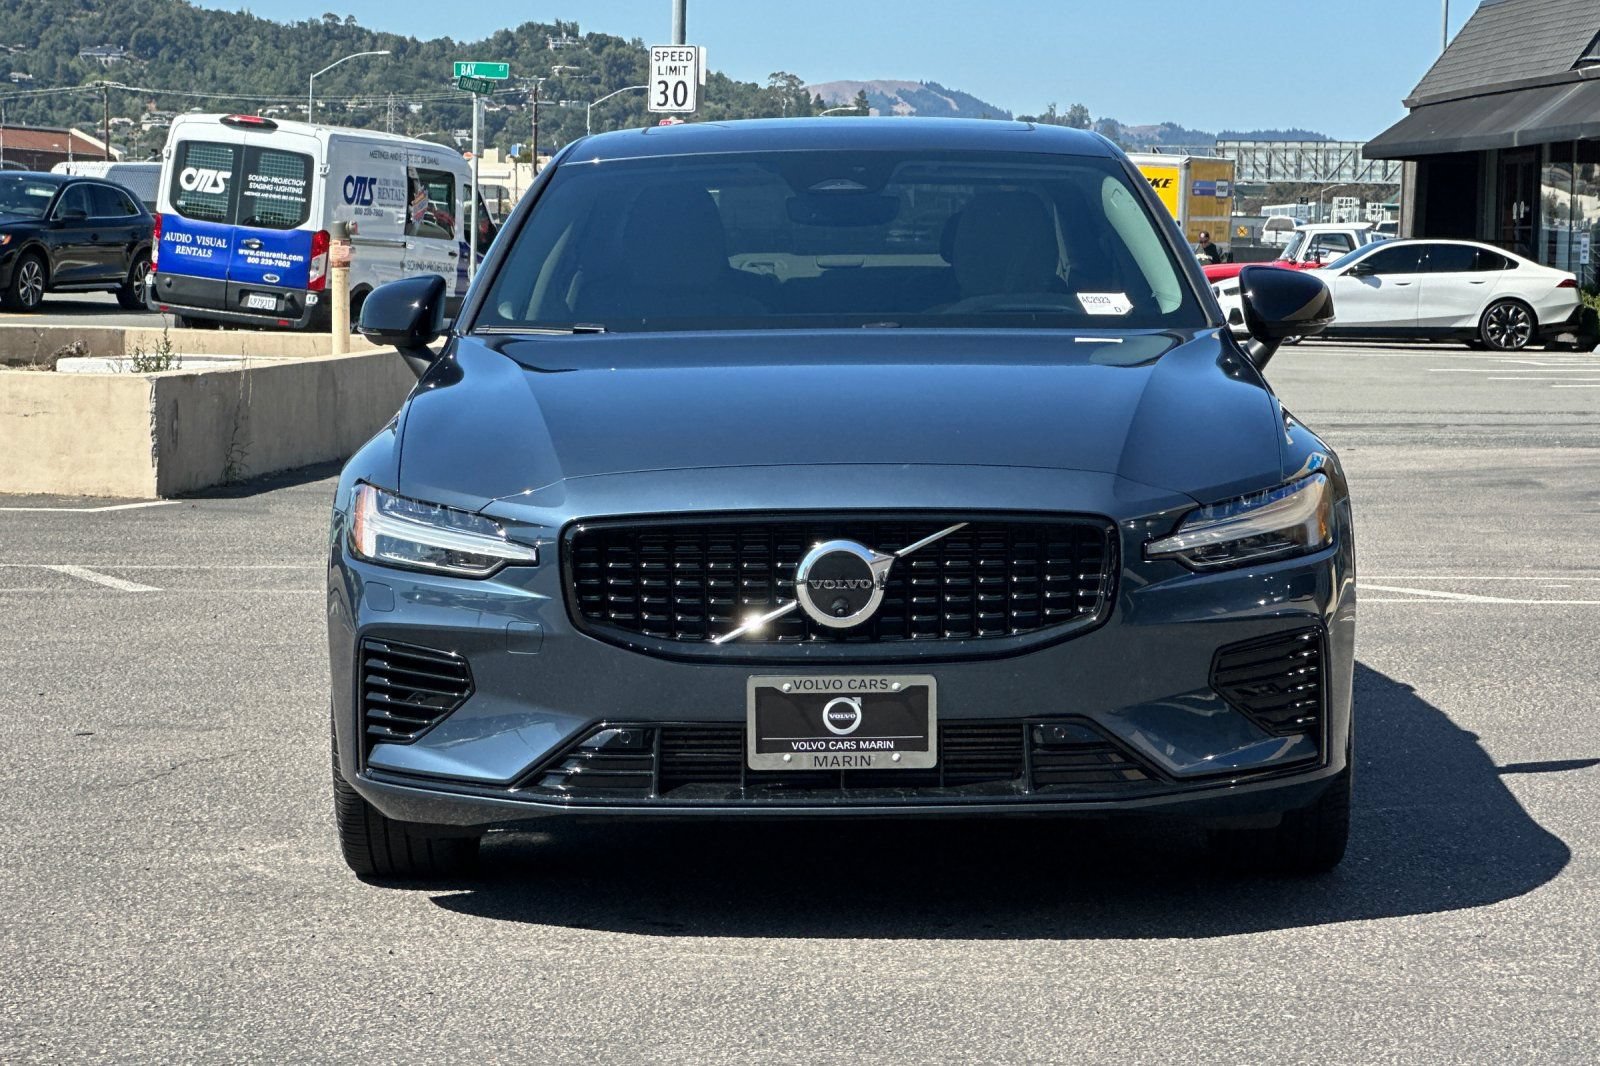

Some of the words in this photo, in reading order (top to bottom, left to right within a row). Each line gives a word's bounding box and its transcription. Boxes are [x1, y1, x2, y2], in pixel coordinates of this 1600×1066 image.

[654, 51, 693, 62] SPEED
[461, 64, 476, 76] BAY
[657, 65, 688, 76] LIMIT
[656, 80, 688, 107] 30
[248, 174, 268, 182] SOUND
[271, 177, 306, 187] PROJECTION
[1146, 178, 1173, 188] KE
[249, 182, 273, 190] STAGING
[275, 185, 303, 194] LIGHTING
[377, 187, 405, 201] RENTALS
[164, 232, 192, 243] AUDIO
[196, 235, 228, 249] VISUAL
[175, 245, 213, 258] RENTALS
[247, 256, 260, 264] 800
[1081, 296, 1111, 304] AC2923
[808, 579, 872, 589] VOLVO
[793, 679, 843, 690] VOLVO
[847, 678, 889, 690] CARS
[791, 741, 826, 750] VOLVO
[828, 740, 857, 750] CARS
[859, 740, 894, 749] MARIN
[813, 755, 872, 767] MARIN
